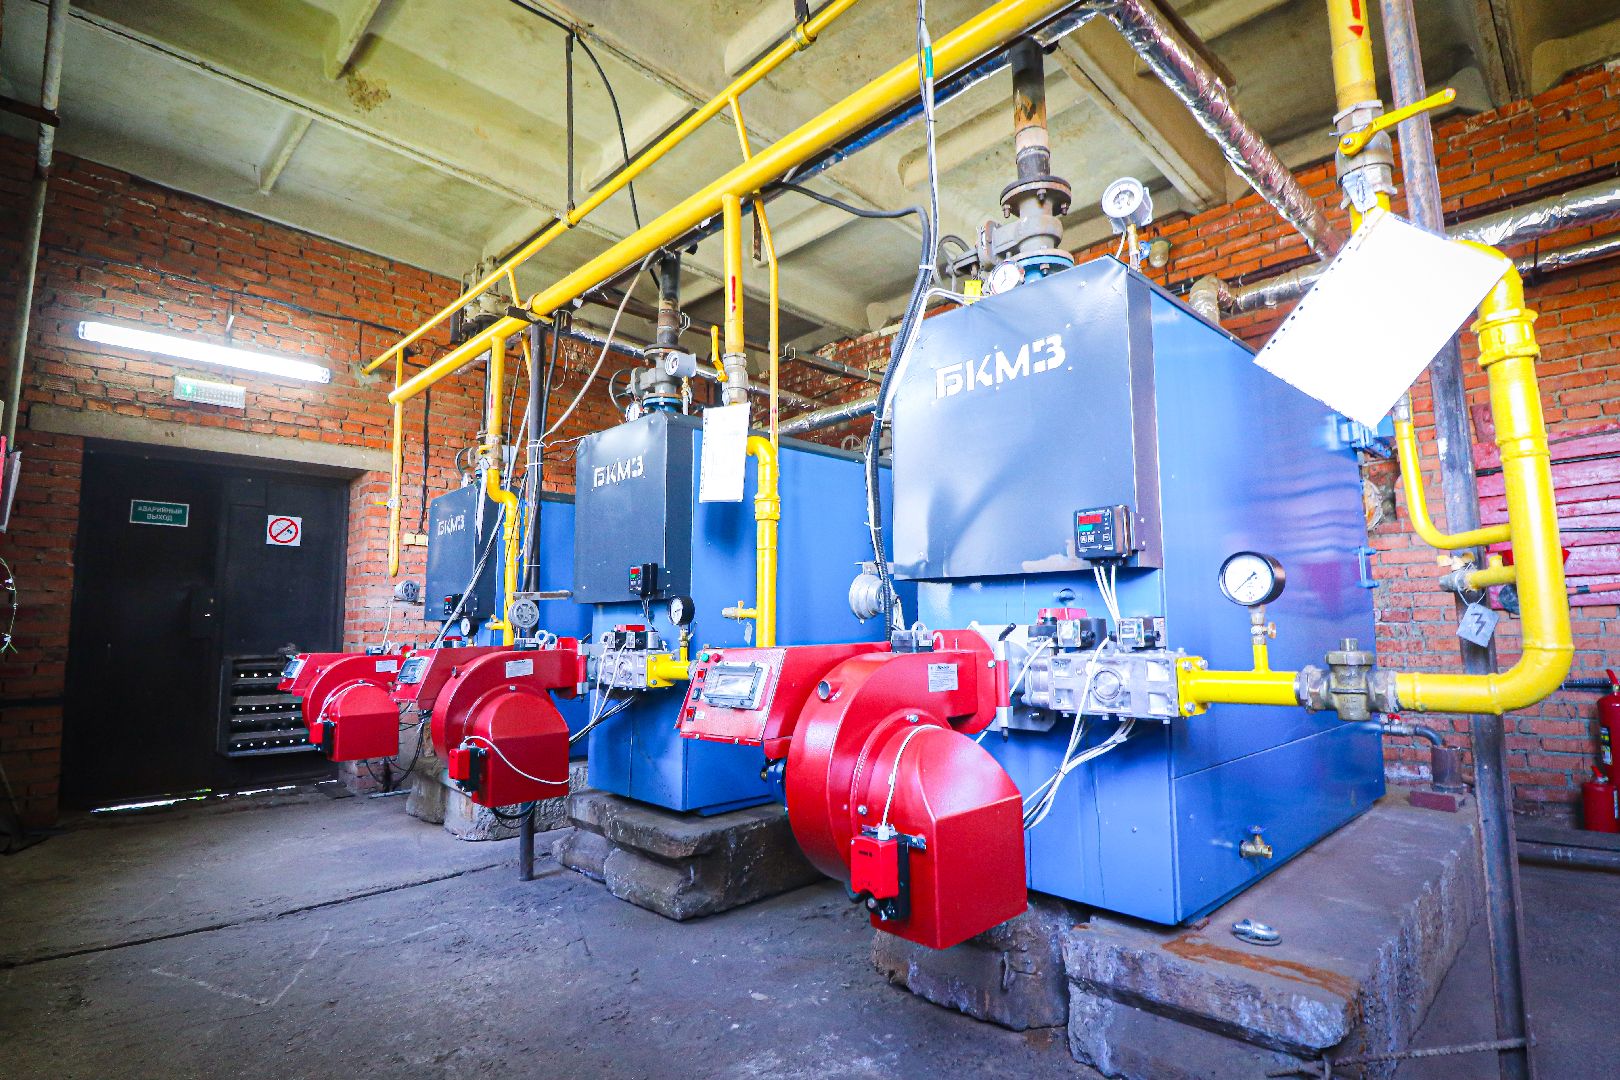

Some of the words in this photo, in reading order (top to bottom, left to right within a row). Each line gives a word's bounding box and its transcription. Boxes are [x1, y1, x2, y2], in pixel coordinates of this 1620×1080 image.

[936, 334, 1066, 400] БКМЗ
[593, 455, 643, 487] БКМЗ
[438, 514, 465, 536] БКМЗ
